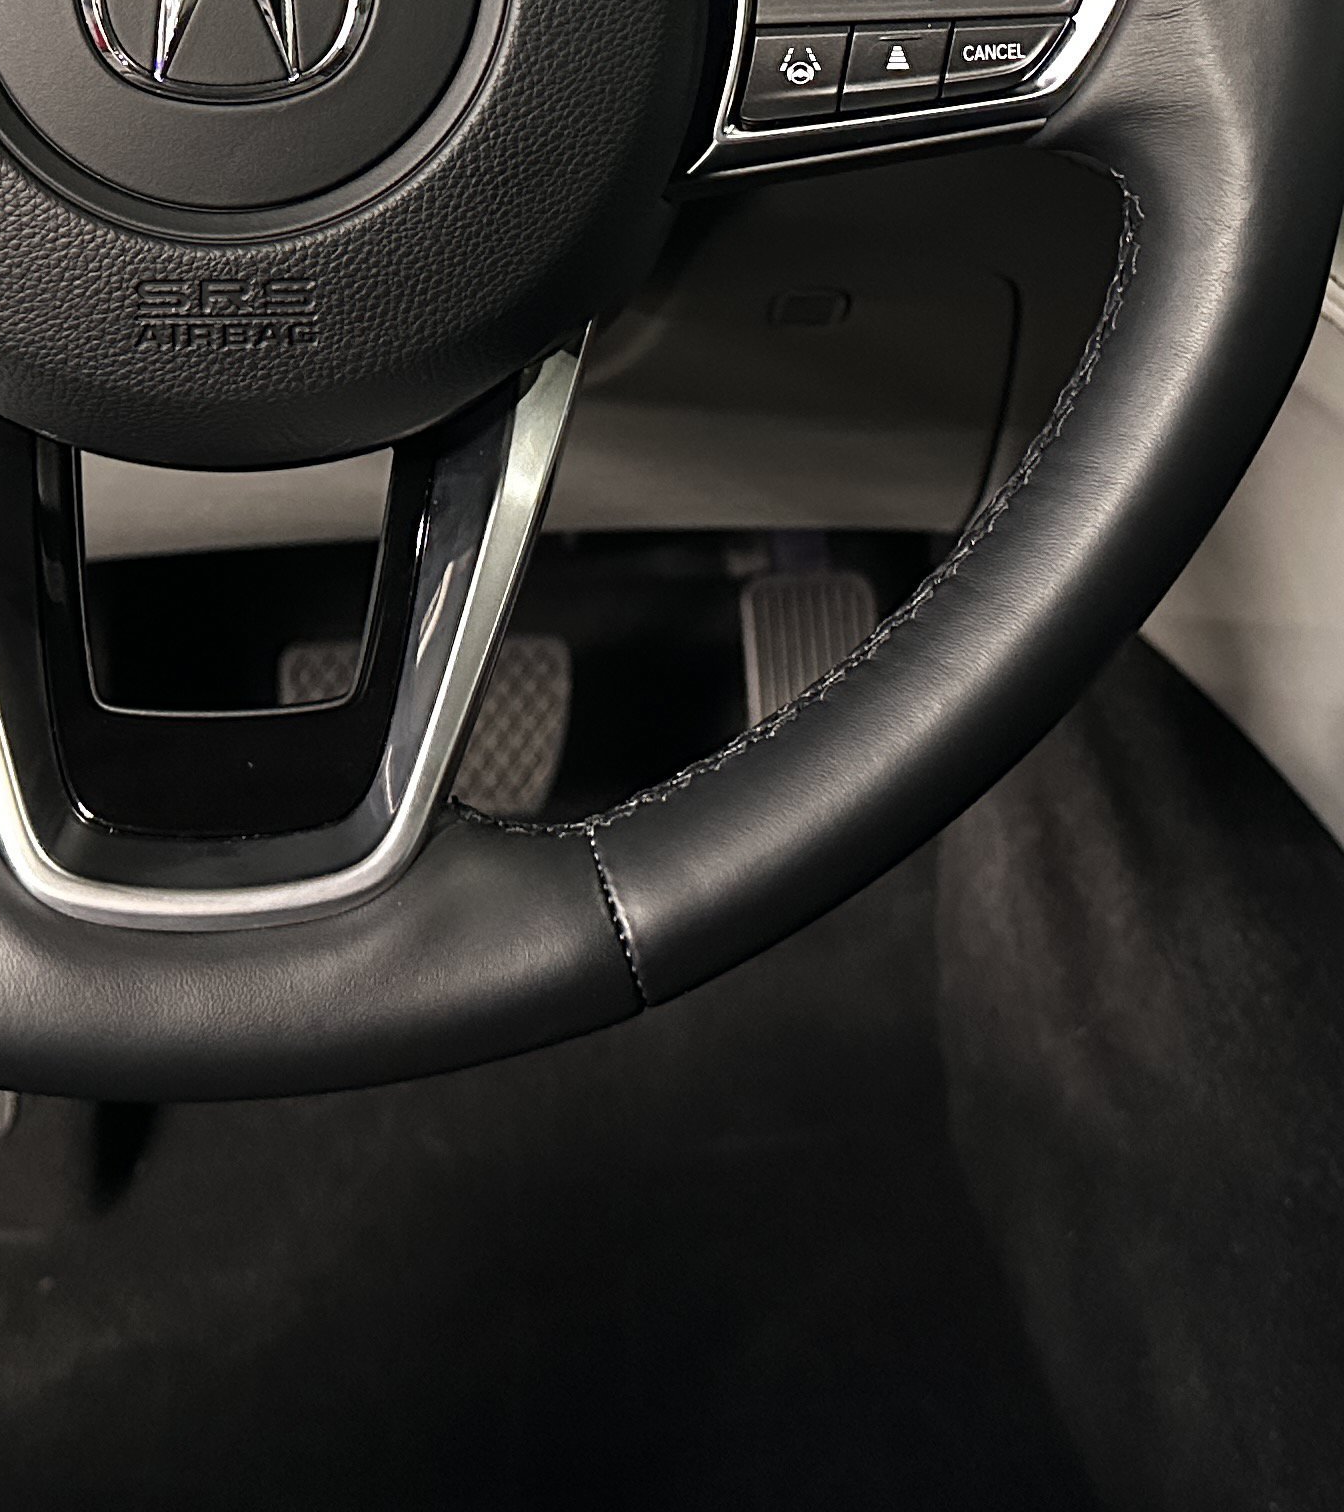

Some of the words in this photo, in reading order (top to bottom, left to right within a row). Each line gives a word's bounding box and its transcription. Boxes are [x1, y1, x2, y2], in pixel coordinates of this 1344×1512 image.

[962, 42, 1026, 63] CANCEL
[136, 278, 317, 315] SRS
[135, 322, 321, 351] AIRBAG
